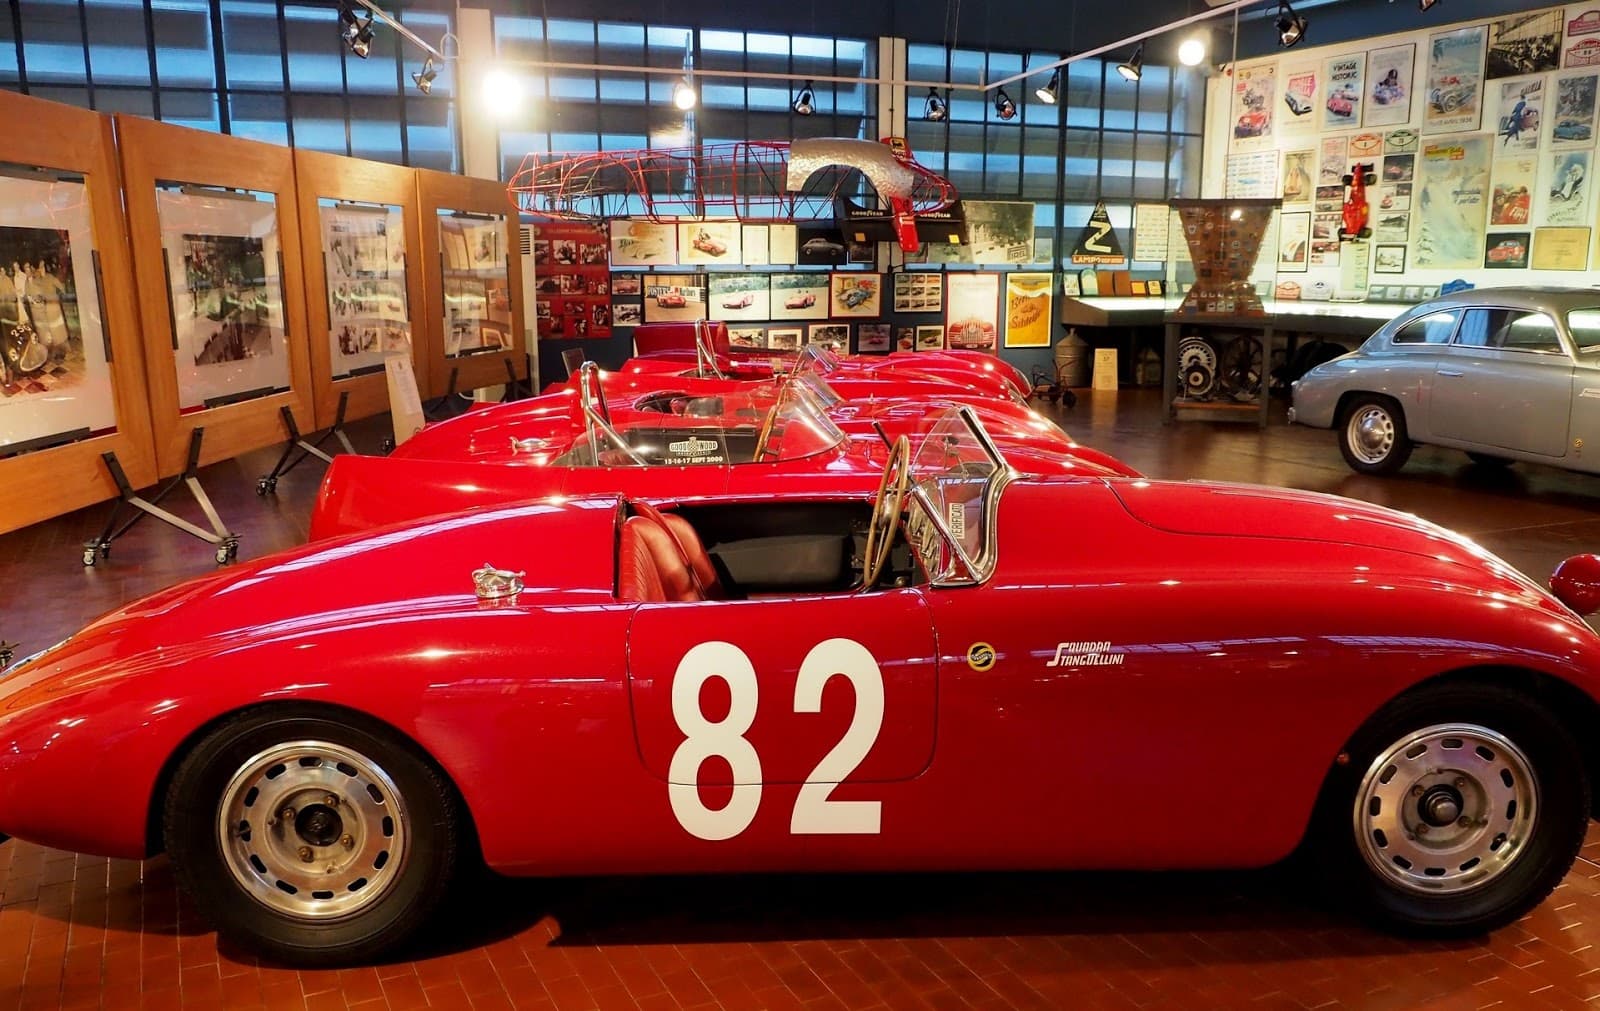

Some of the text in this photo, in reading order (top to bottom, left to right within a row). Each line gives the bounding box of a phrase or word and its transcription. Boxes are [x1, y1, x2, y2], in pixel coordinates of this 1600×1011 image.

[1333, 62, 1357, 71] VINTAGE
[851, 209, 884, 217] GOODYEAR
[951, 503, 963, 538] VERIFICATO
[668, 637, 885, 841] 82
